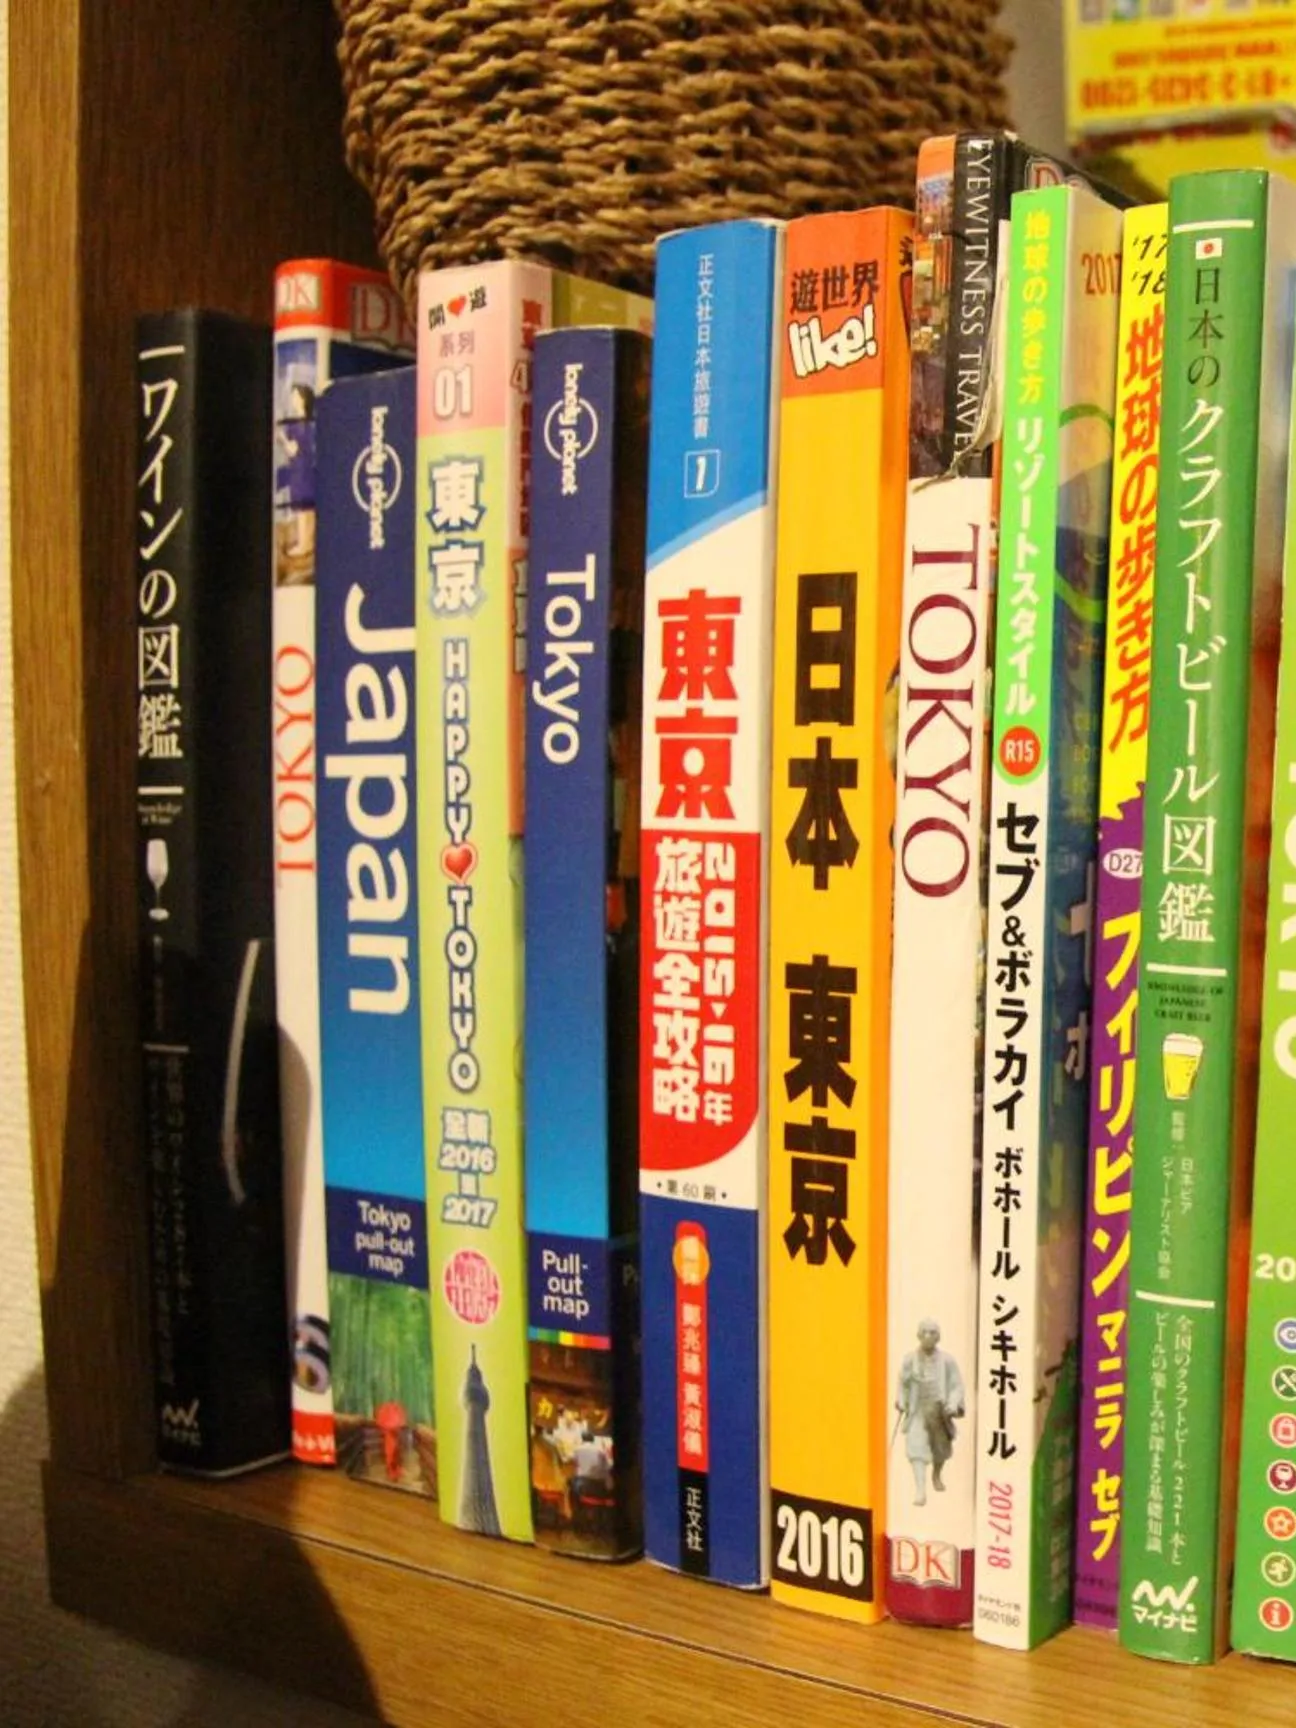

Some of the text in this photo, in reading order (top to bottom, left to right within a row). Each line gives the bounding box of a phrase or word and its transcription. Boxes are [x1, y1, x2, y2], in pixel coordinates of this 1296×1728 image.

[960, 138, 994, 336] EYEWITNESS
[789, 259, 880, 315] 遊世界
[787, 304, 877, 381] like!
[434, 364, 473, 420] 01
[558, 363, 583, 496] lonely planet
[365, 405, 389, 550] lonely planet
[695, 454, 707, 492] 1
[1005, 210, 1050, 717] 地球の歩き方 リゾートスタイル
[138, 379, 186, 761] ワインの図鑑
[425, 453, 488, 620] 東京
[1110, 303, 1165, 753] 地球の歩き方
[1157, 266, 1228, 944] 日本のクラフトビール図鑑
[532, 553, 595, 765] Tokyo
[654, 588, 742, 820] 東京
[901, 522, 983, 898] TOKYO
[1003, 738, 1036, 764] R15
[325, 582, 417, 1016] Japan
[443, 637, 480, 1094] HAPPY TOKYO
[1109, 854, 1142, 874] D27
[784, 571, 860, 1268] 日本 東京
[652, 834, 702, 1124] 旅遊全攻略
[439, 1142, 498, 1174] 2016
[986, 802, 1040, 1570] セブ&ボラカイ ボホール シキホール 2017-18
[355, 1231, 415, 1258] pull-out
[357, 1200, 411, 1234] Tokyo
[441, 1194, 499, 1229] 2017
[368, 1253, 403, 1278] map
[542, 1250, 589, 1276] Pull-
[543, 1294, 590, 1321] map
[547, 1274, 584, 1297] out
[1093, 1310, 1126, 1450] マニラ
[776, 1503, 865, 1589] 2016
[896, 1539, 952, 1582] DK
[1090, 1467, 1121, 1562] セブ
[1131, 1603, 1199, 1633] マイナビ
